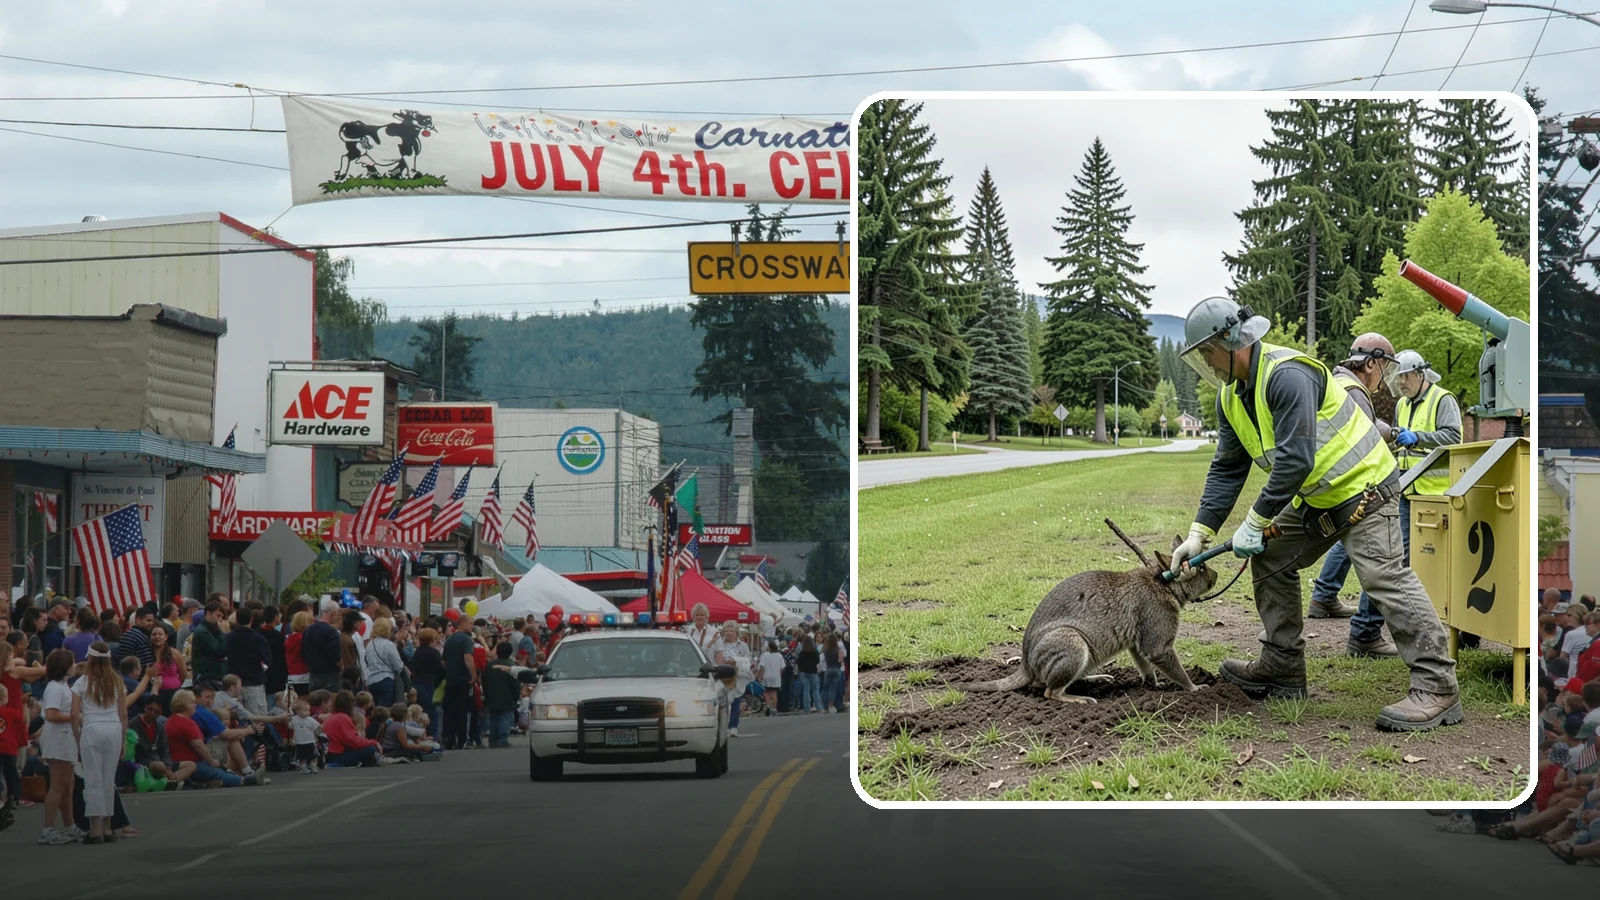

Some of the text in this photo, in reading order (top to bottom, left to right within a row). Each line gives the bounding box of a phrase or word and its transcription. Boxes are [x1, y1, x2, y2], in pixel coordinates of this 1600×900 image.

[481, 141, 605, 193] JULY
[632, 150, 746, 197] 4th.
[697, 254, 850, 280] CROSSWA
[283, 380, 373, 420] ACE
[405, 409, 452, 422] CEDAR
[284, 421, 370, 436] Hardware
[416, 428, 477, 446] Coca-Cola
[83, 485, 155, 495] St. Vincent de Paul
[688, 526, 741, 535] CRNATION
[699, 535, 730, 543] GLASS
[1466, 520, 1496, 614] 2
